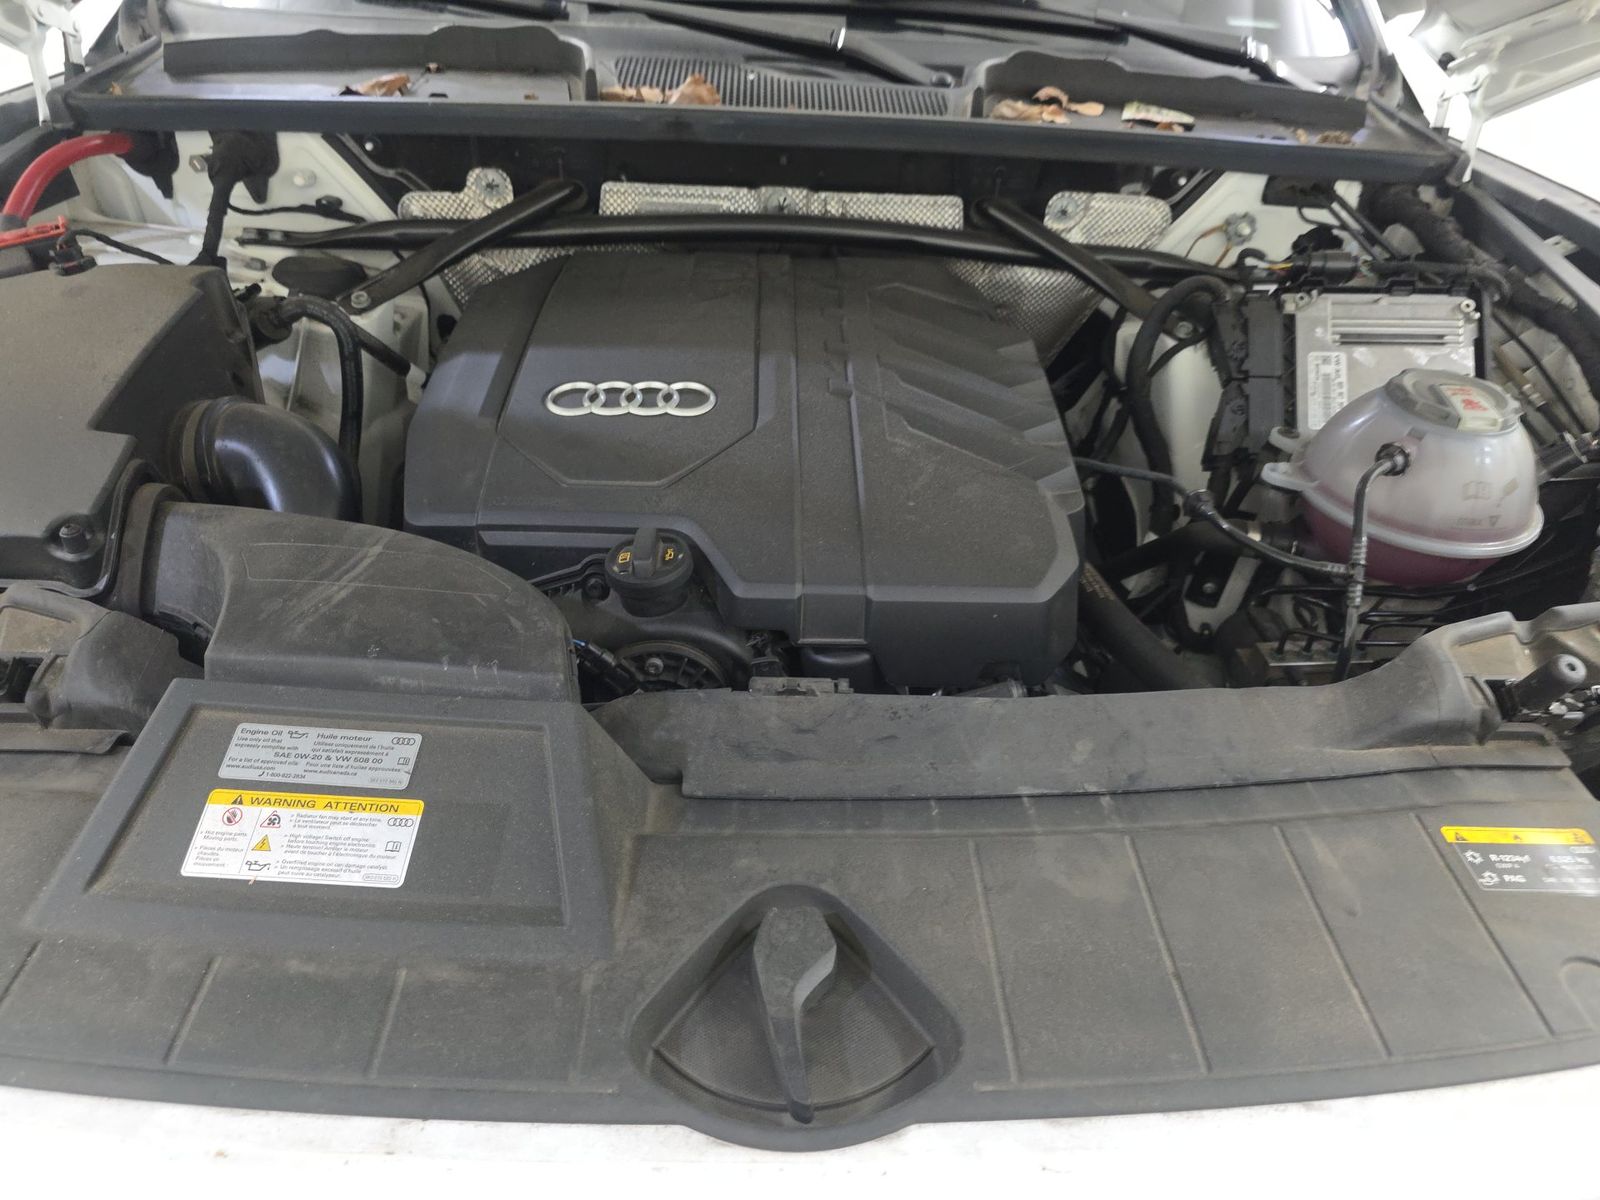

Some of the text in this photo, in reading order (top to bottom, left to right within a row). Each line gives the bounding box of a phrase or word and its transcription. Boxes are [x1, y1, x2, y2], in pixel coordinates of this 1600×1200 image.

[240, 727, 269, 738] Engine
[316, 732, 338, 740] Huile
[335, 742, 368, 750] uniquement
[294, 752, 323, 760] 0W-20
[303, 768, 357, 776] www.audicanada.ca
[250, 796, 400, 813] WARNING ATTENTION
[1502, 874, 1527, 882] PAG
